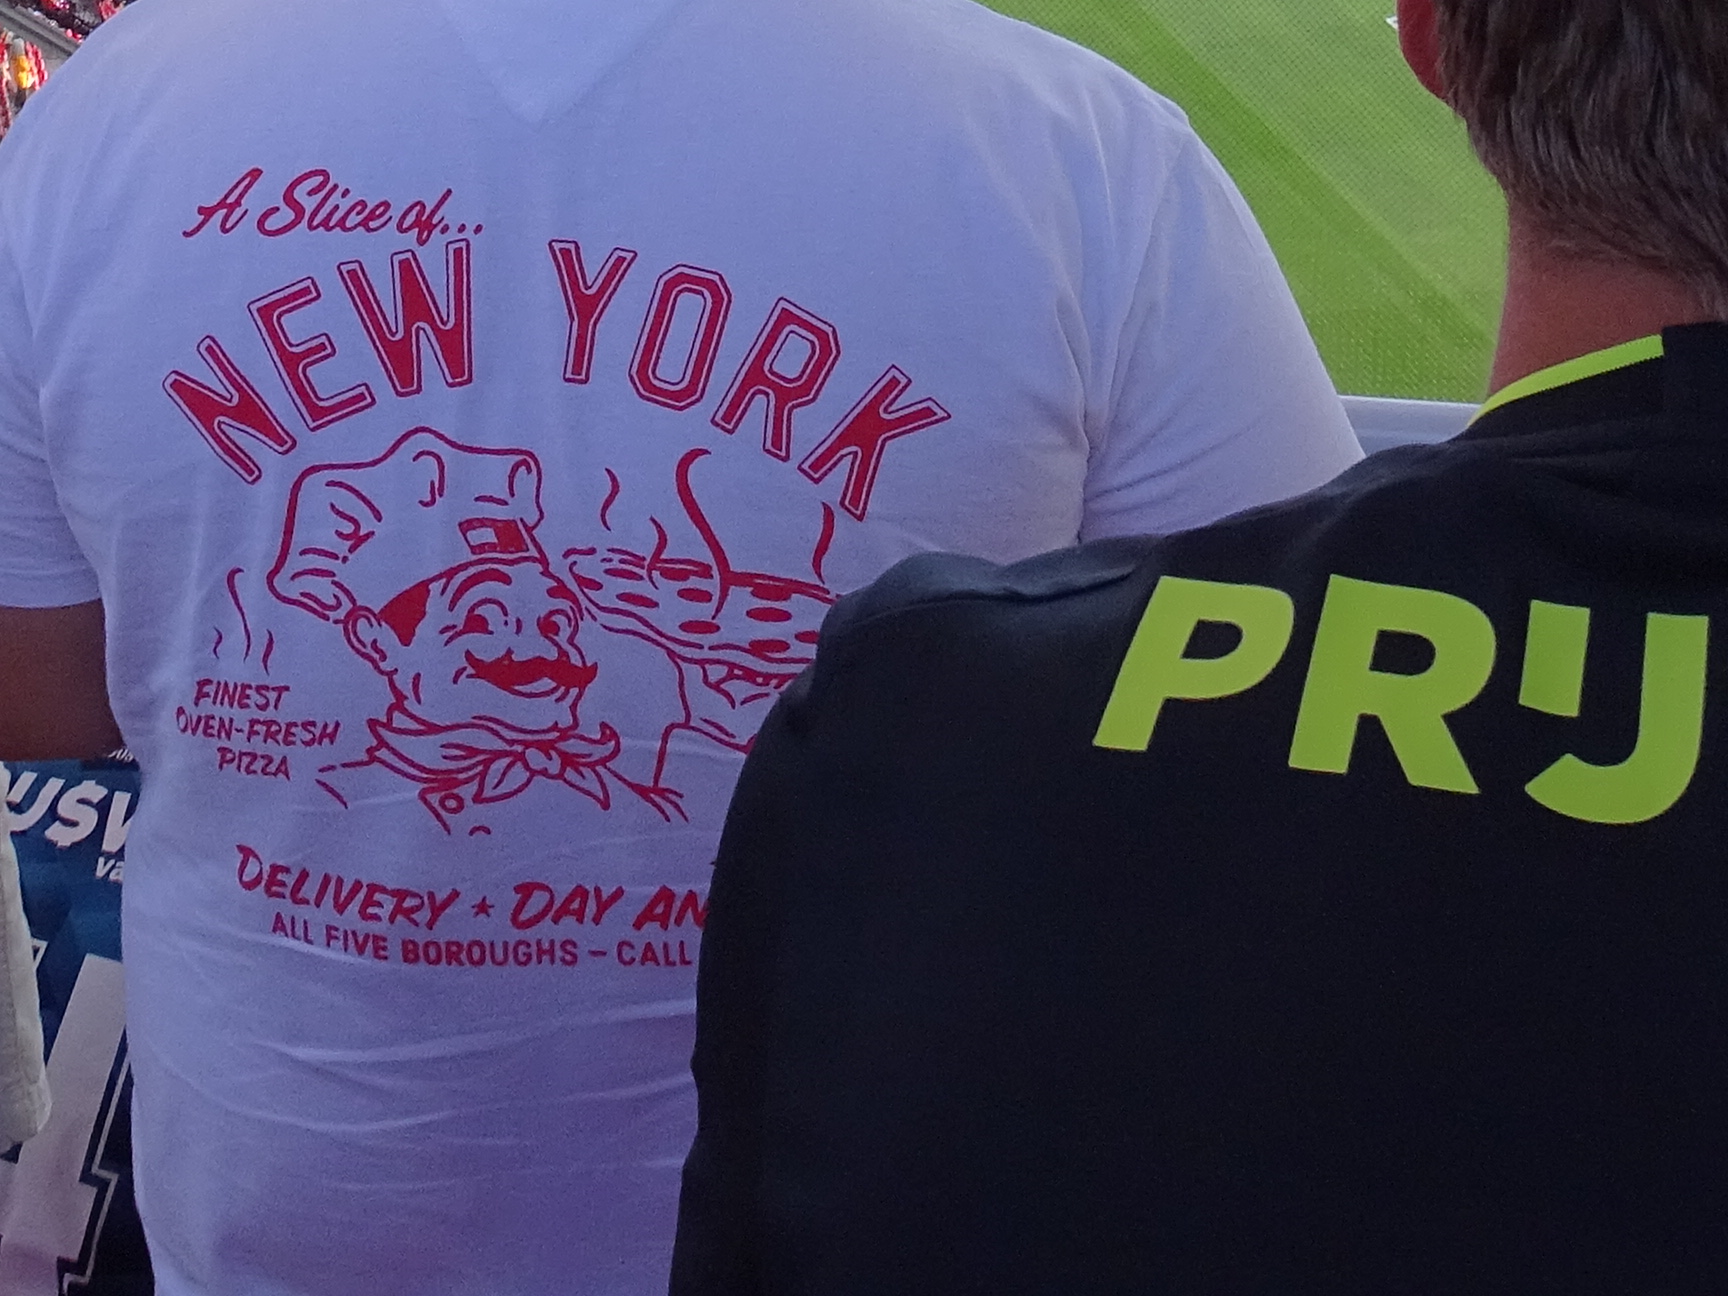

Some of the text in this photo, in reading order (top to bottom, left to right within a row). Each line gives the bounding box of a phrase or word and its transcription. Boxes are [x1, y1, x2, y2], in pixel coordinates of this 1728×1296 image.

[181, 166, 264, 239] A
[256, 168, 393, 237] Slice
[161, 236, 953, 523] NEW YORK
[193, 677, 292, 714] FINEST
[175, 706, 341, 749] OVEN-FRESH
[217, 745, 291, 782] PIZZA
[234, 842, 710, 932] DELIVERY DAY AN
[271, 910, 316, 948] ALL
[325, 924, 392, 962] FIVE
[399, 935, 579, 969] BOROUGHS
[616, 939, 693, 968] CALL
